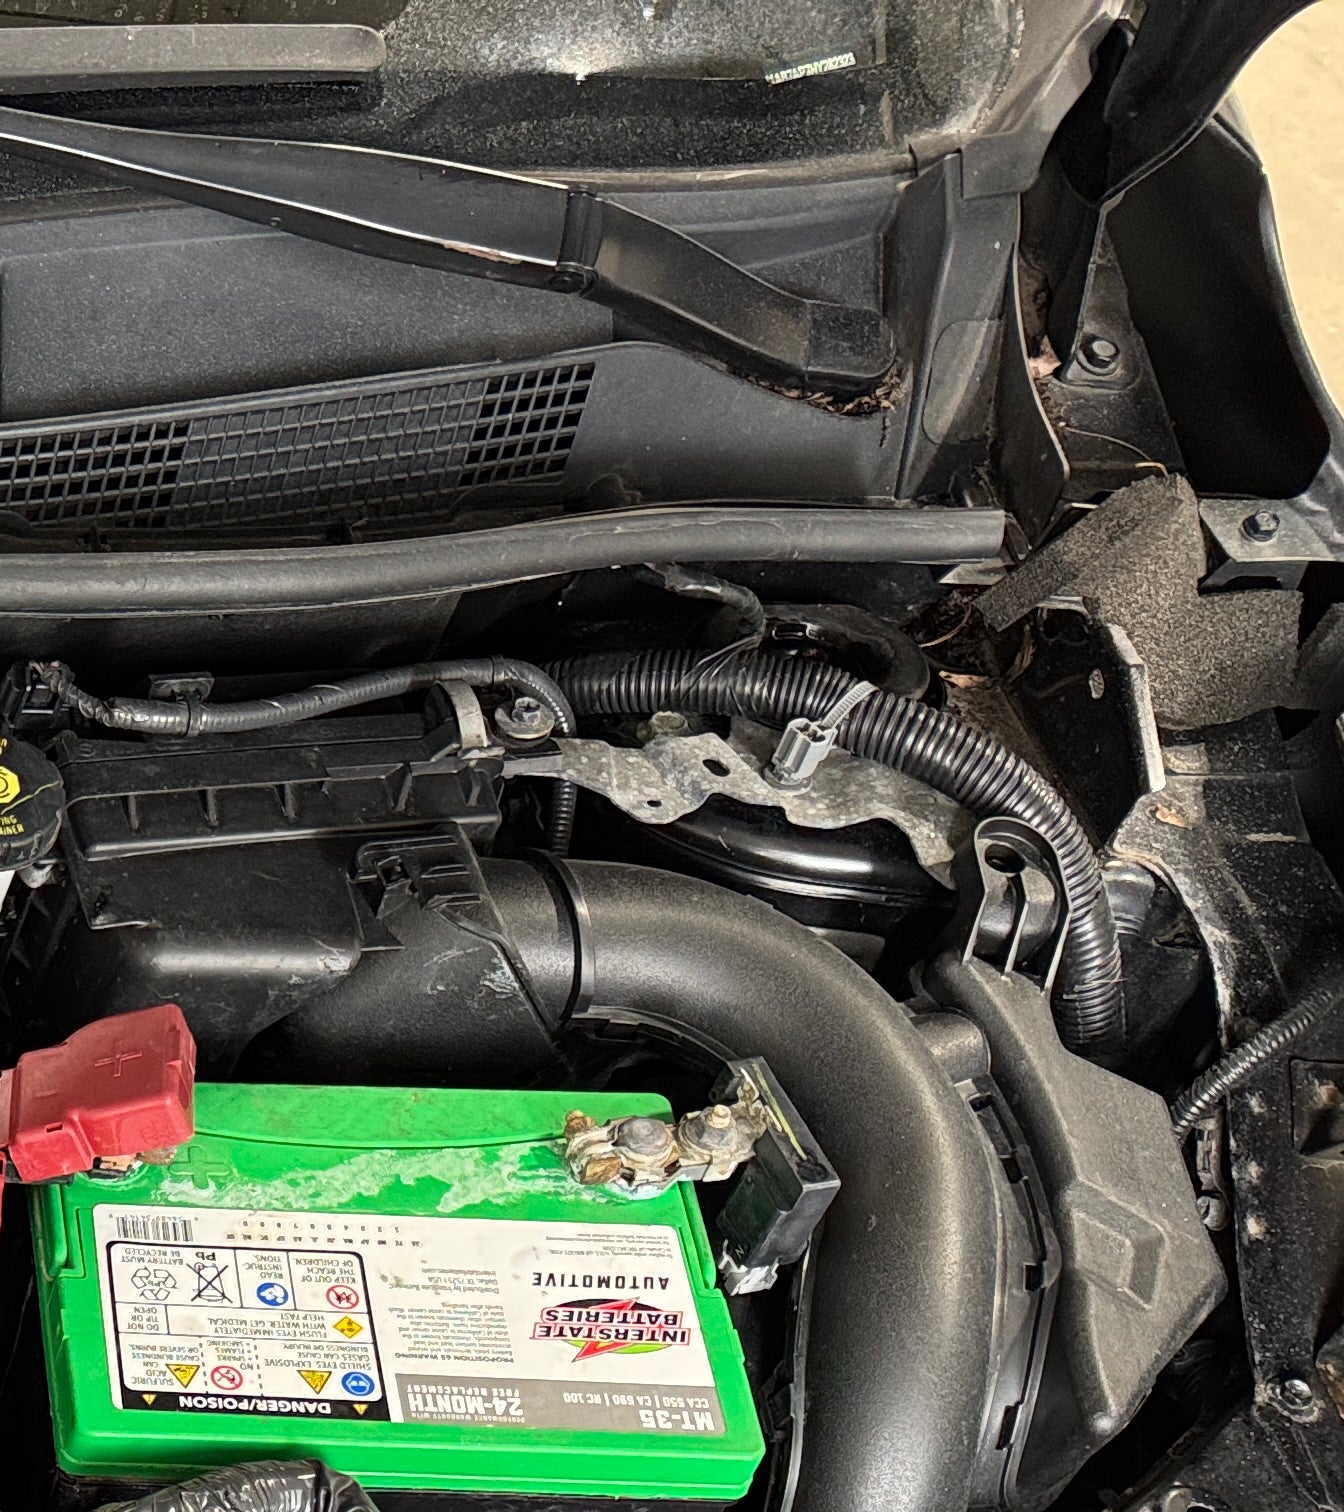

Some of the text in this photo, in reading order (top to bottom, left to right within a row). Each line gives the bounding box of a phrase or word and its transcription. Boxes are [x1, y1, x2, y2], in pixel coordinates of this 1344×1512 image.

[121, 1255, 183, 1265] BATTERY MUST
[195, 1252, 216, 1261] Pb
[335, 1276, 356, 1284] KEEP
[532, 1272, 669, 1290] AUTOMOTIVE
[146, 1315, 158, 1323] TIP
[207, 1318, 247, 1326] MEDICAL
[544, 1310, 678, 1326] BATTERIES
[127, 1322, 144, 1330] NOT
[249, 1320, 265, 1328] GET
[214, 1326, 274, 1337] IMMEDIATELY
[276, 1329, 297, 1337] EYES
[537, 1325, 687, 1343] INTERSTATE
[215, 1347, 245, 1355] FLAMES
[176, 1354, 200, 1362] CAUSE
[217, 1354, 246, 1362] SPARKS
[341, 1354, 370, 1362] GASES
[453, 1355, 514, 1363] PROPOSITION
[264, 1358, 311, 1369] EXPLOSIVE
[340, 1362, 371, 1370] SHIELD
[131, 1377, 174, 1386] SULFURIC
[407, 1384, 520, 1397] FREE REPLACEMENT
[563, 1392, 583, 1403] 100
[586, 1393, 601, 1404] RC
[637, 1395, 652, 1406] CA
[662, 1396, 684, 1407] 550
[686, 1397, 709, 1408] CCA
[178, 1395, 333, 1415] DANGER/POISON
[407, 1393, 523, 1416] 24-MONTH
[639, 1409, 715, 1431] MT-35
